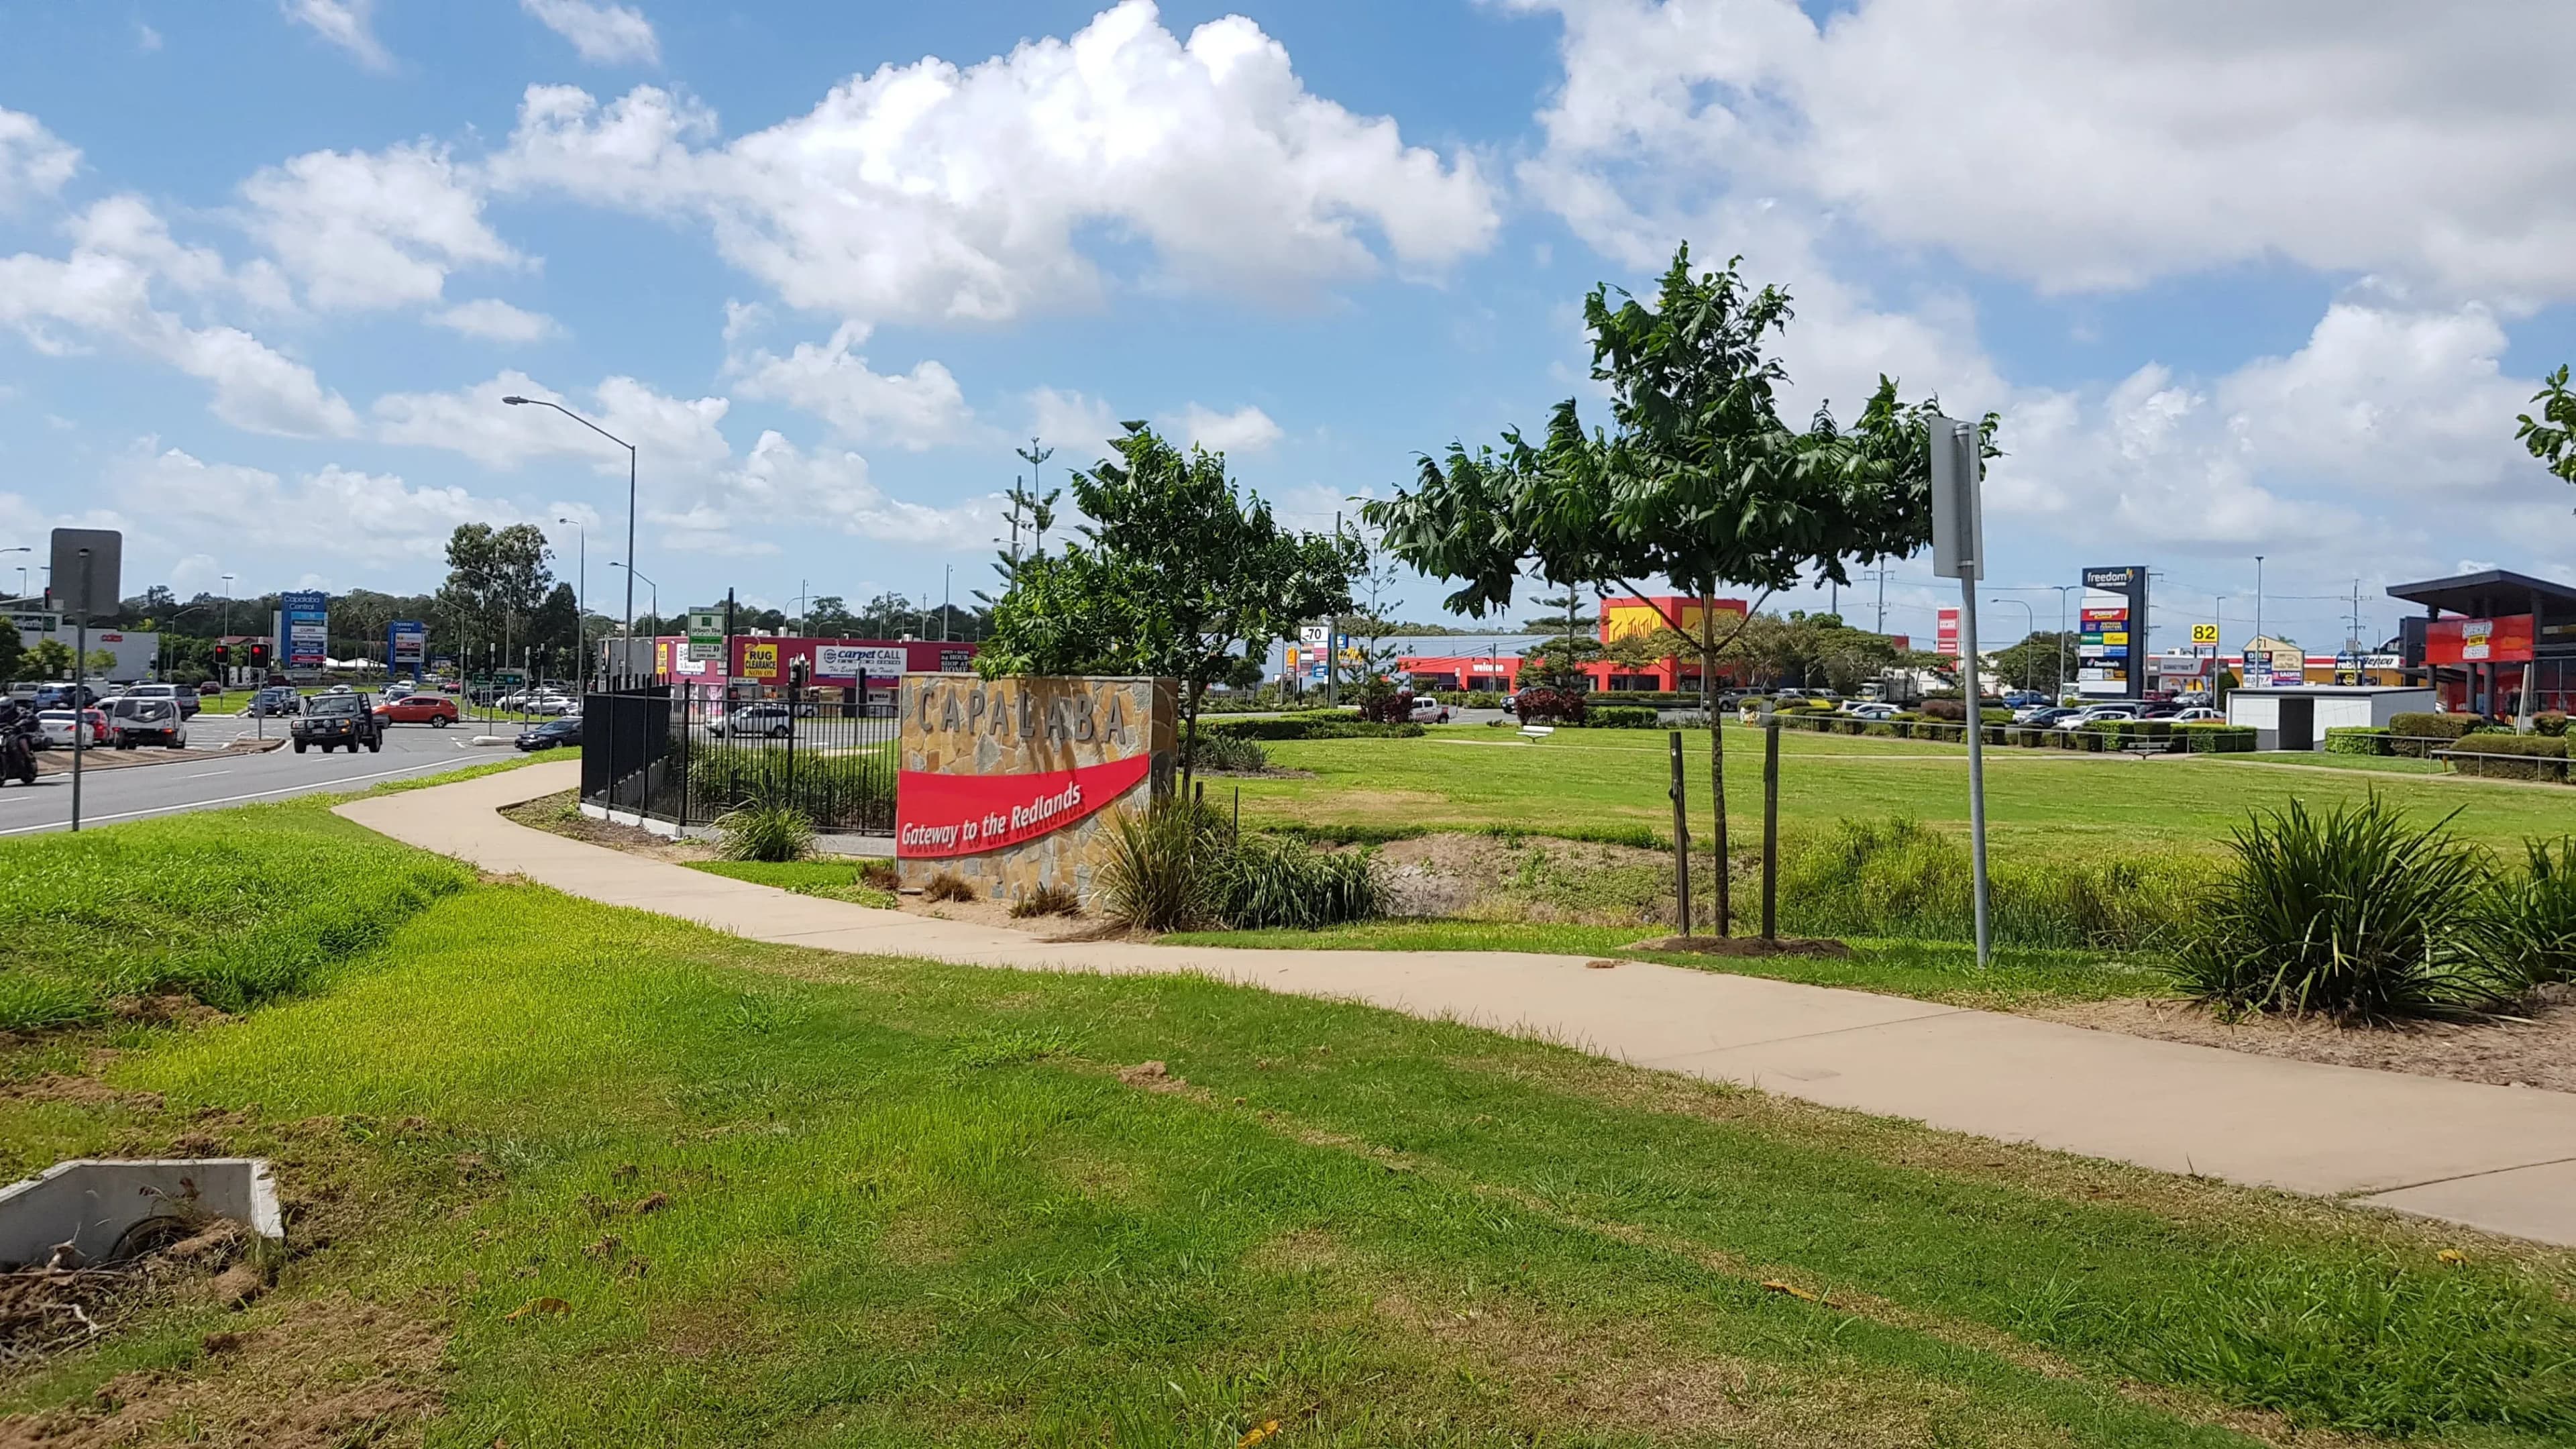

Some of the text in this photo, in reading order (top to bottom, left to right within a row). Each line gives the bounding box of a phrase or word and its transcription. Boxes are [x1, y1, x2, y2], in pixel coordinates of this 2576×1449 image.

[2088, 572, 2127, 582] freedom
[1308, 629, 1322, 639] 70
[2194, 626, 2216, 639] 82
[749, 651, 772, 660] RUG
[837, 650, 900, 660] carpet CALL
[745, 660, 776, 669] CLEARANCE
[1472, 661, 1504, 672] welcome
[2363, 657, 2394, 666] Repco
[918, 687, 1126, 745] CAPALABA
[902, 780, 1083, 848] Gateway to the Redlands
